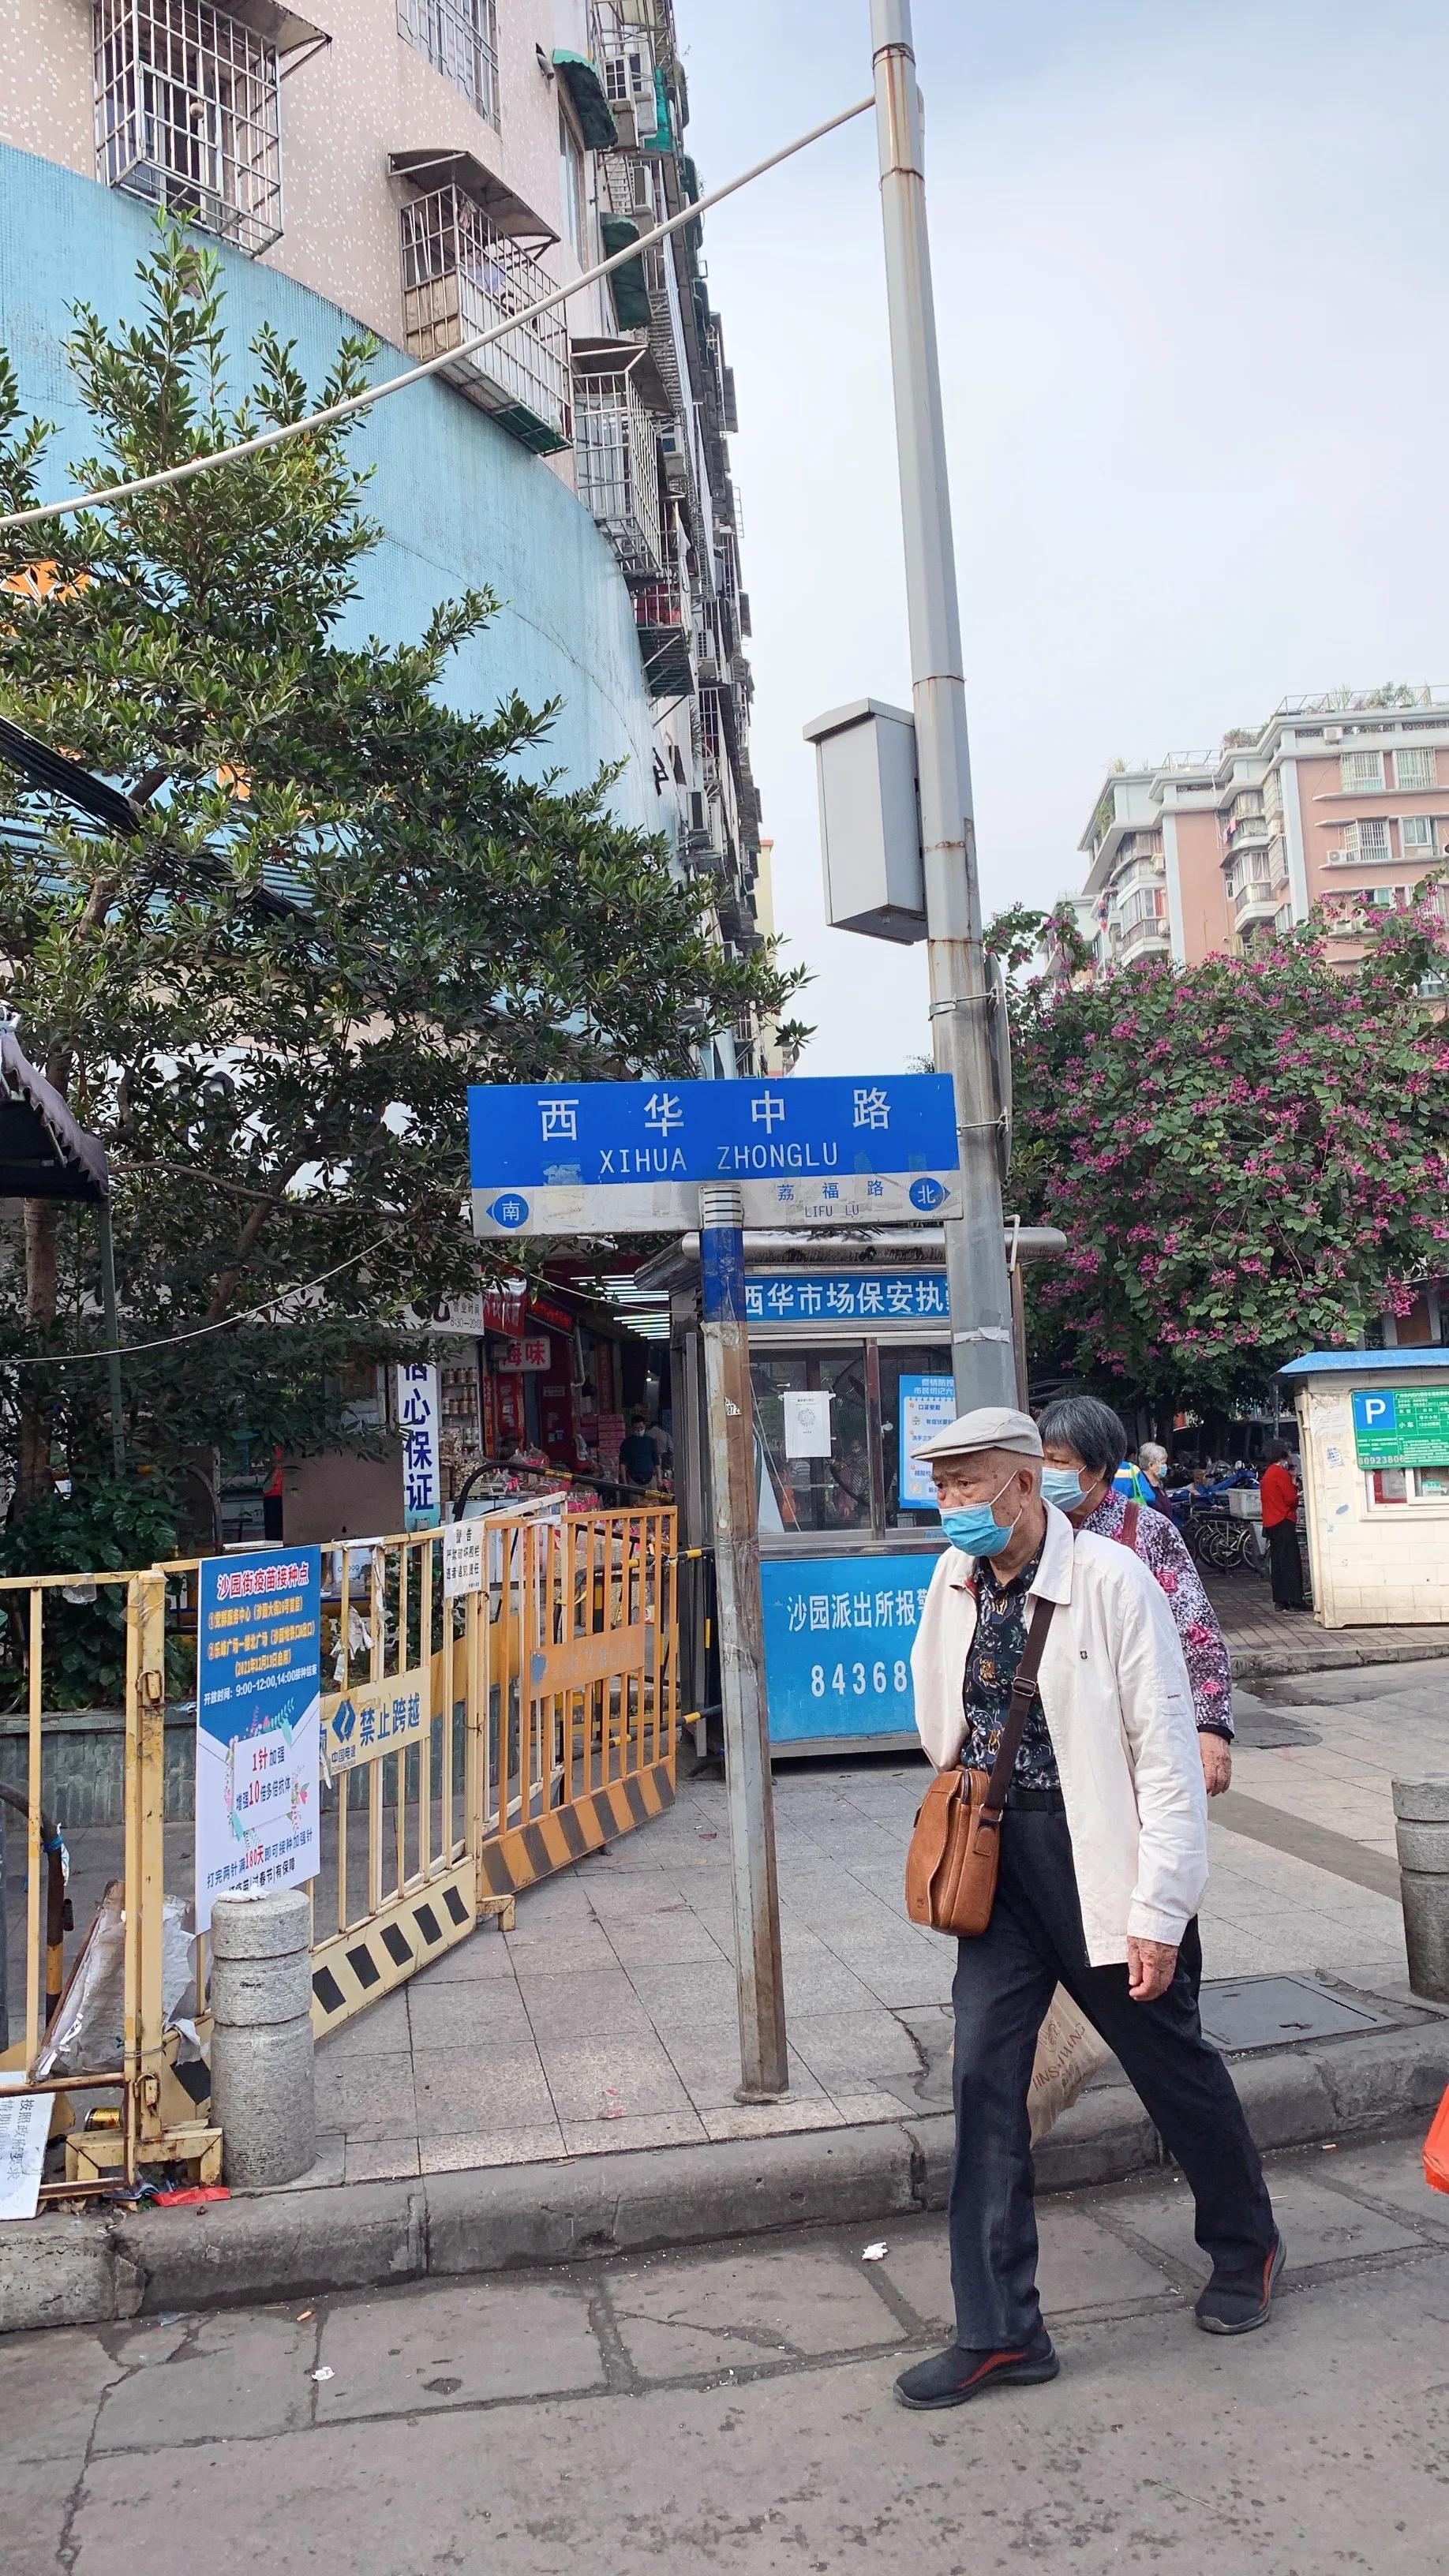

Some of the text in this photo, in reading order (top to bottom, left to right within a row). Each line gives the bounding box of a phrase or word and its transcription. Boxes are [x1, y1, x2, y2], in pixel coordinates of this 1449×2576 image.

[537, 1087, 892, 1142] 西华中路
[600, 1142, 838, 1174] XIHUA ZHONGLU
[777, 1179, 885, 1202] 荔福路
[916, 1185, 935, 1205] 北
[501, 1200, 521, 1222] 南
[804, 1204, 860, 1219] LIFU LU
[746, 1280, 949, 1316] 西华市场保安执
[1365, 1398, 1386, 1425] P
[218, 1562, 309, 1600] 沙园街疫苗接种点
[811, 1660, 908, 1698] 84368
[360, 1692, 420, 1747] 禁止跨越
[7, 2099, 35, 2180] 按照政府要求
